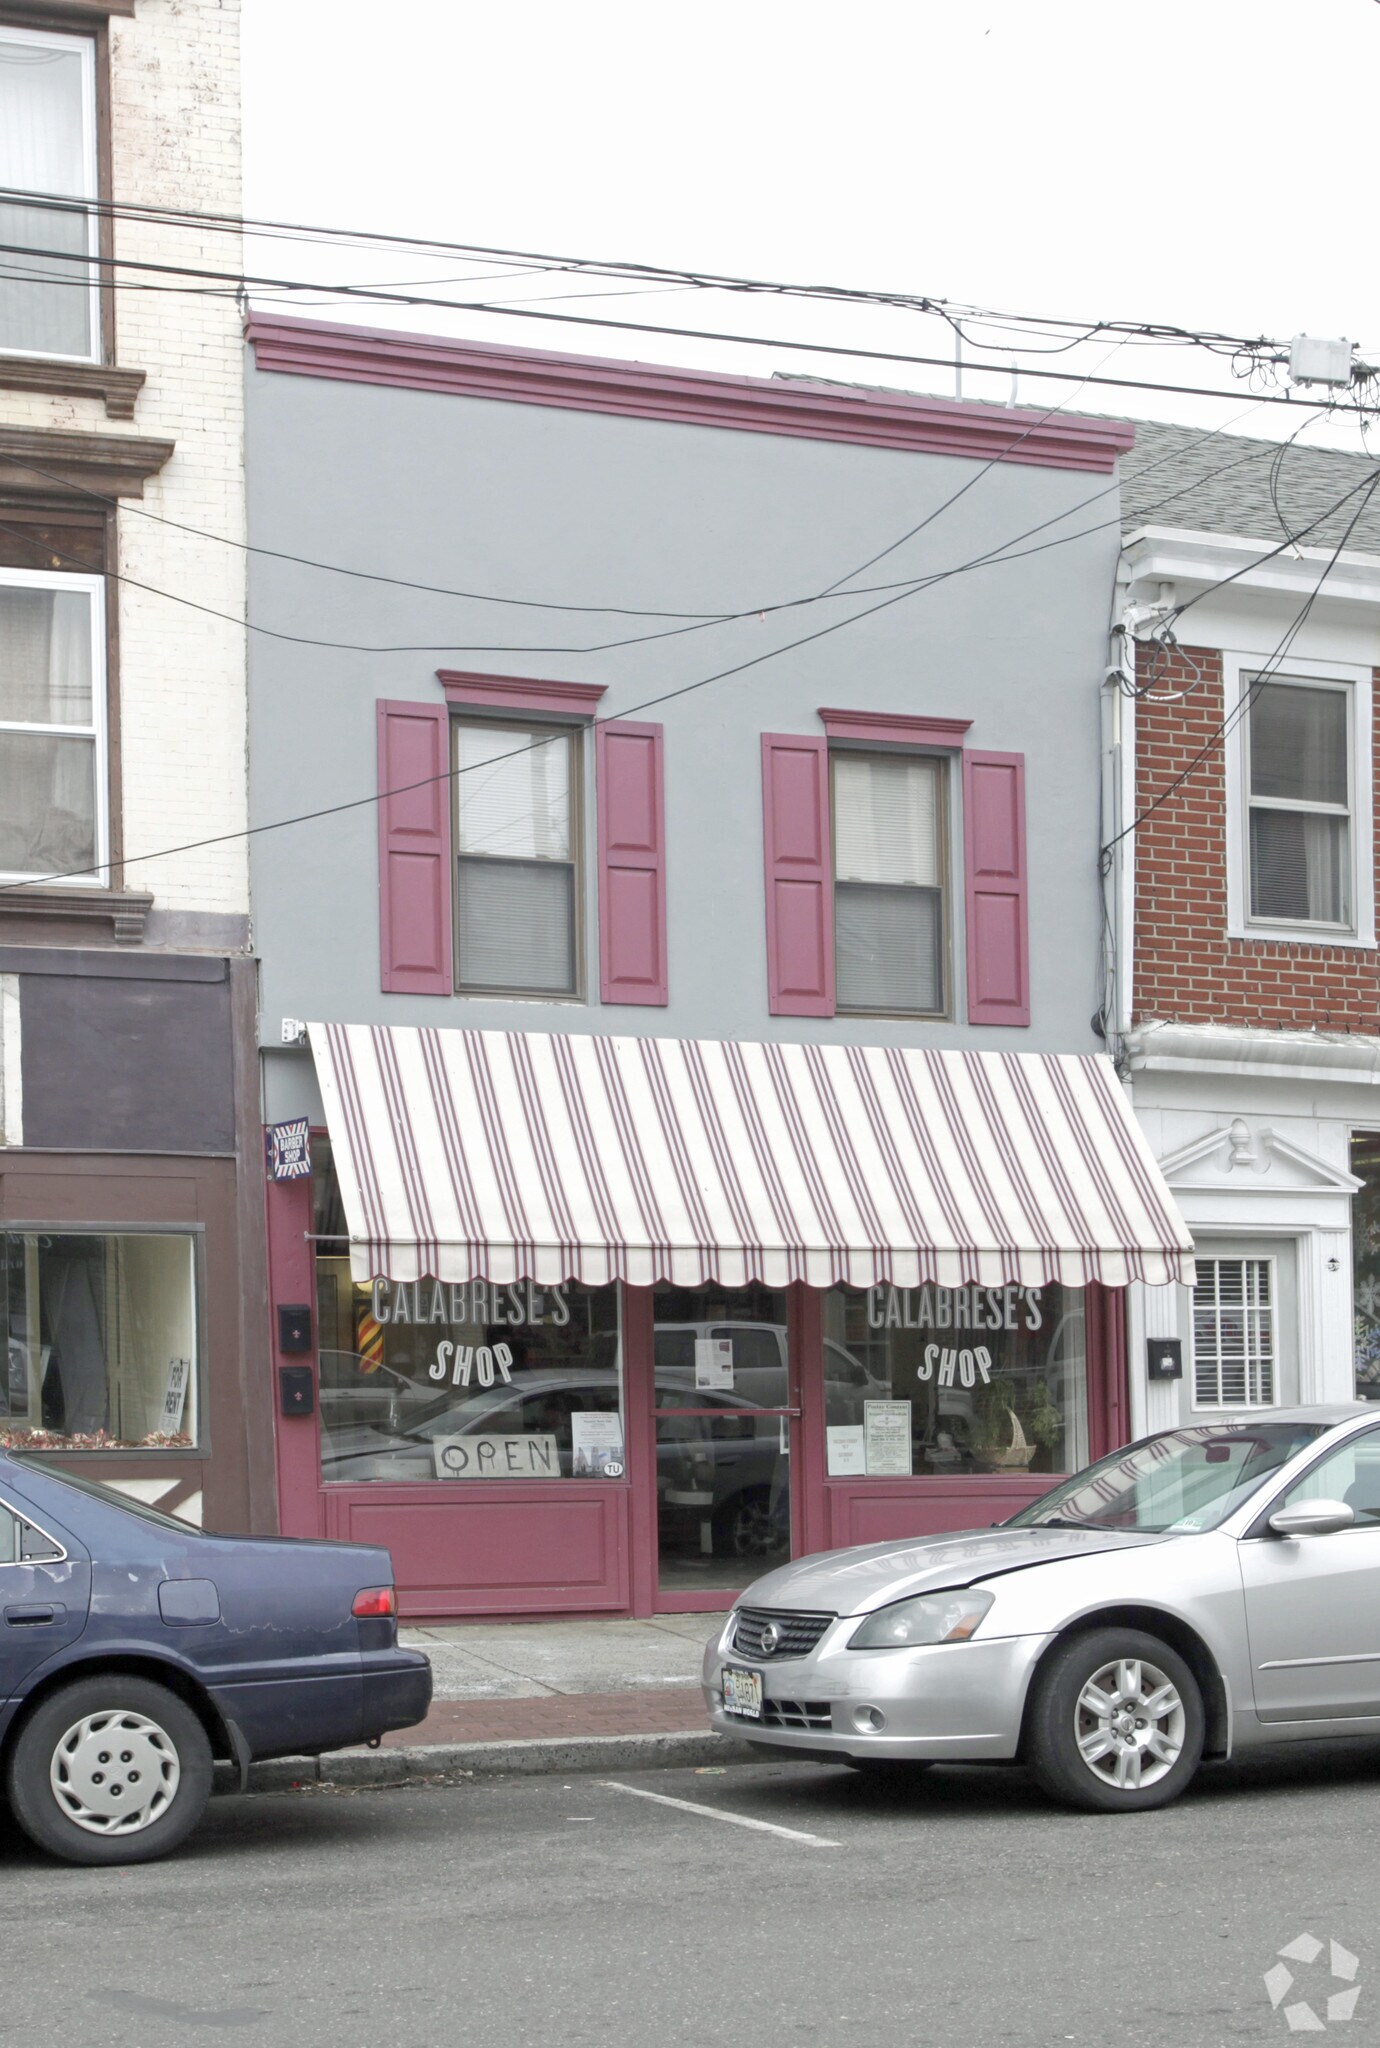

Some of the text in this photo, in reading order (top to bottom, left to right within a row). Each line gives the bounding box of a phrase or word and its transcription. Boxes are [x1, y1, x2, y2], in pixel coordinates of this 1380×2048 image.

[280, 1135, 303, 1151] BARBER
[284, 1149, 301, 1163] SHOP
[867, 1285, 1043, 1331] CALABRESE'S
[429, 1340, 513, 1387] SHOP
[917, 1343, 992, 1388] SHOP
[170, 1366, 183, 1388] FOR
[164, 1391, 181, 1414] RENT
[441, 1441, 551, 1474] OPEN
[607, 1464, 620, 1474] TU
